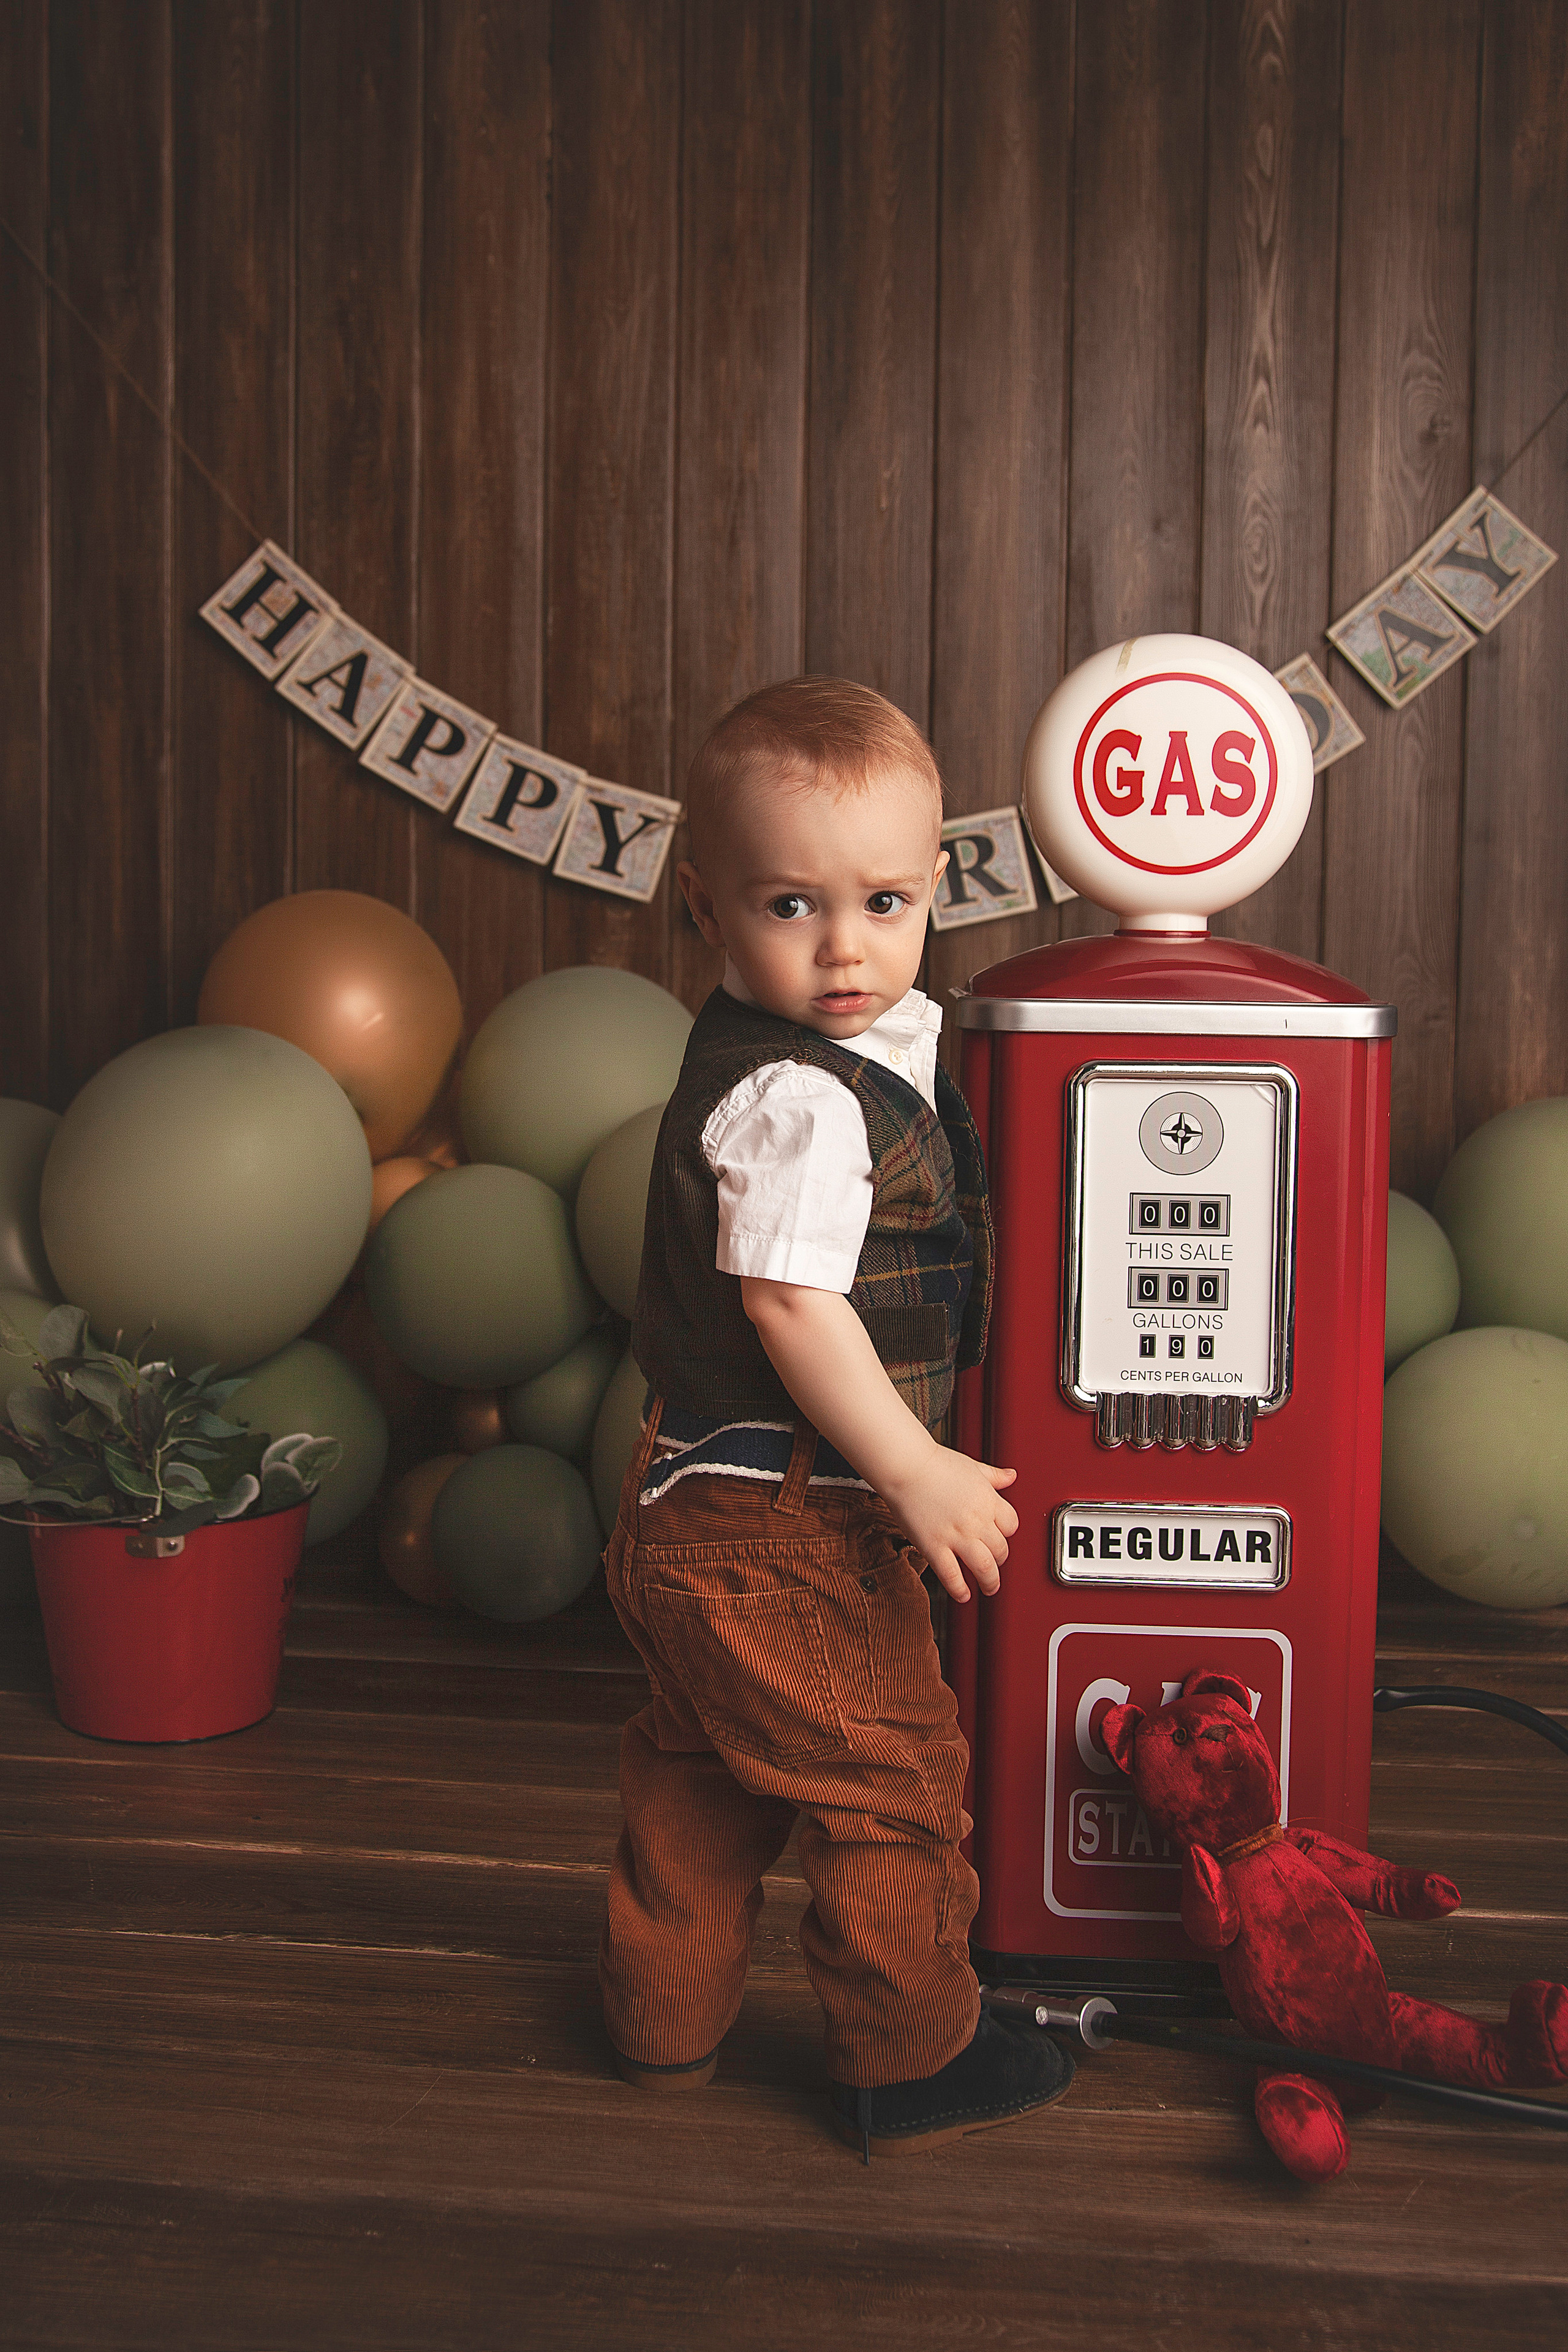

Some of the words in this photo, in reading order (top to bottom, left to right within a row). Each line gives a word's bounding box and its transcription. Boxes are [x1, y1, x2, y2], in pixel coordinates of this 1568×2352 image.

[221, 559, 660, 880] HAPPY
[1093, 729, 1256, 818] GAS
[1125, 1242, 1174, 1260] THIS
[1180, 1243, 1234, 1261] SALE
[1133, 1313, 1223, 1330] GALLONS
[1120, 1370, 1162, 1381] CENTS
[1165, 1371, 1189, 1382] PER
[1192, 1372, 1243, 1383] GALLON
[1068, 1526, 1272, 1564] REGULAR
[1077, 1801, 1170, 1856] STA
